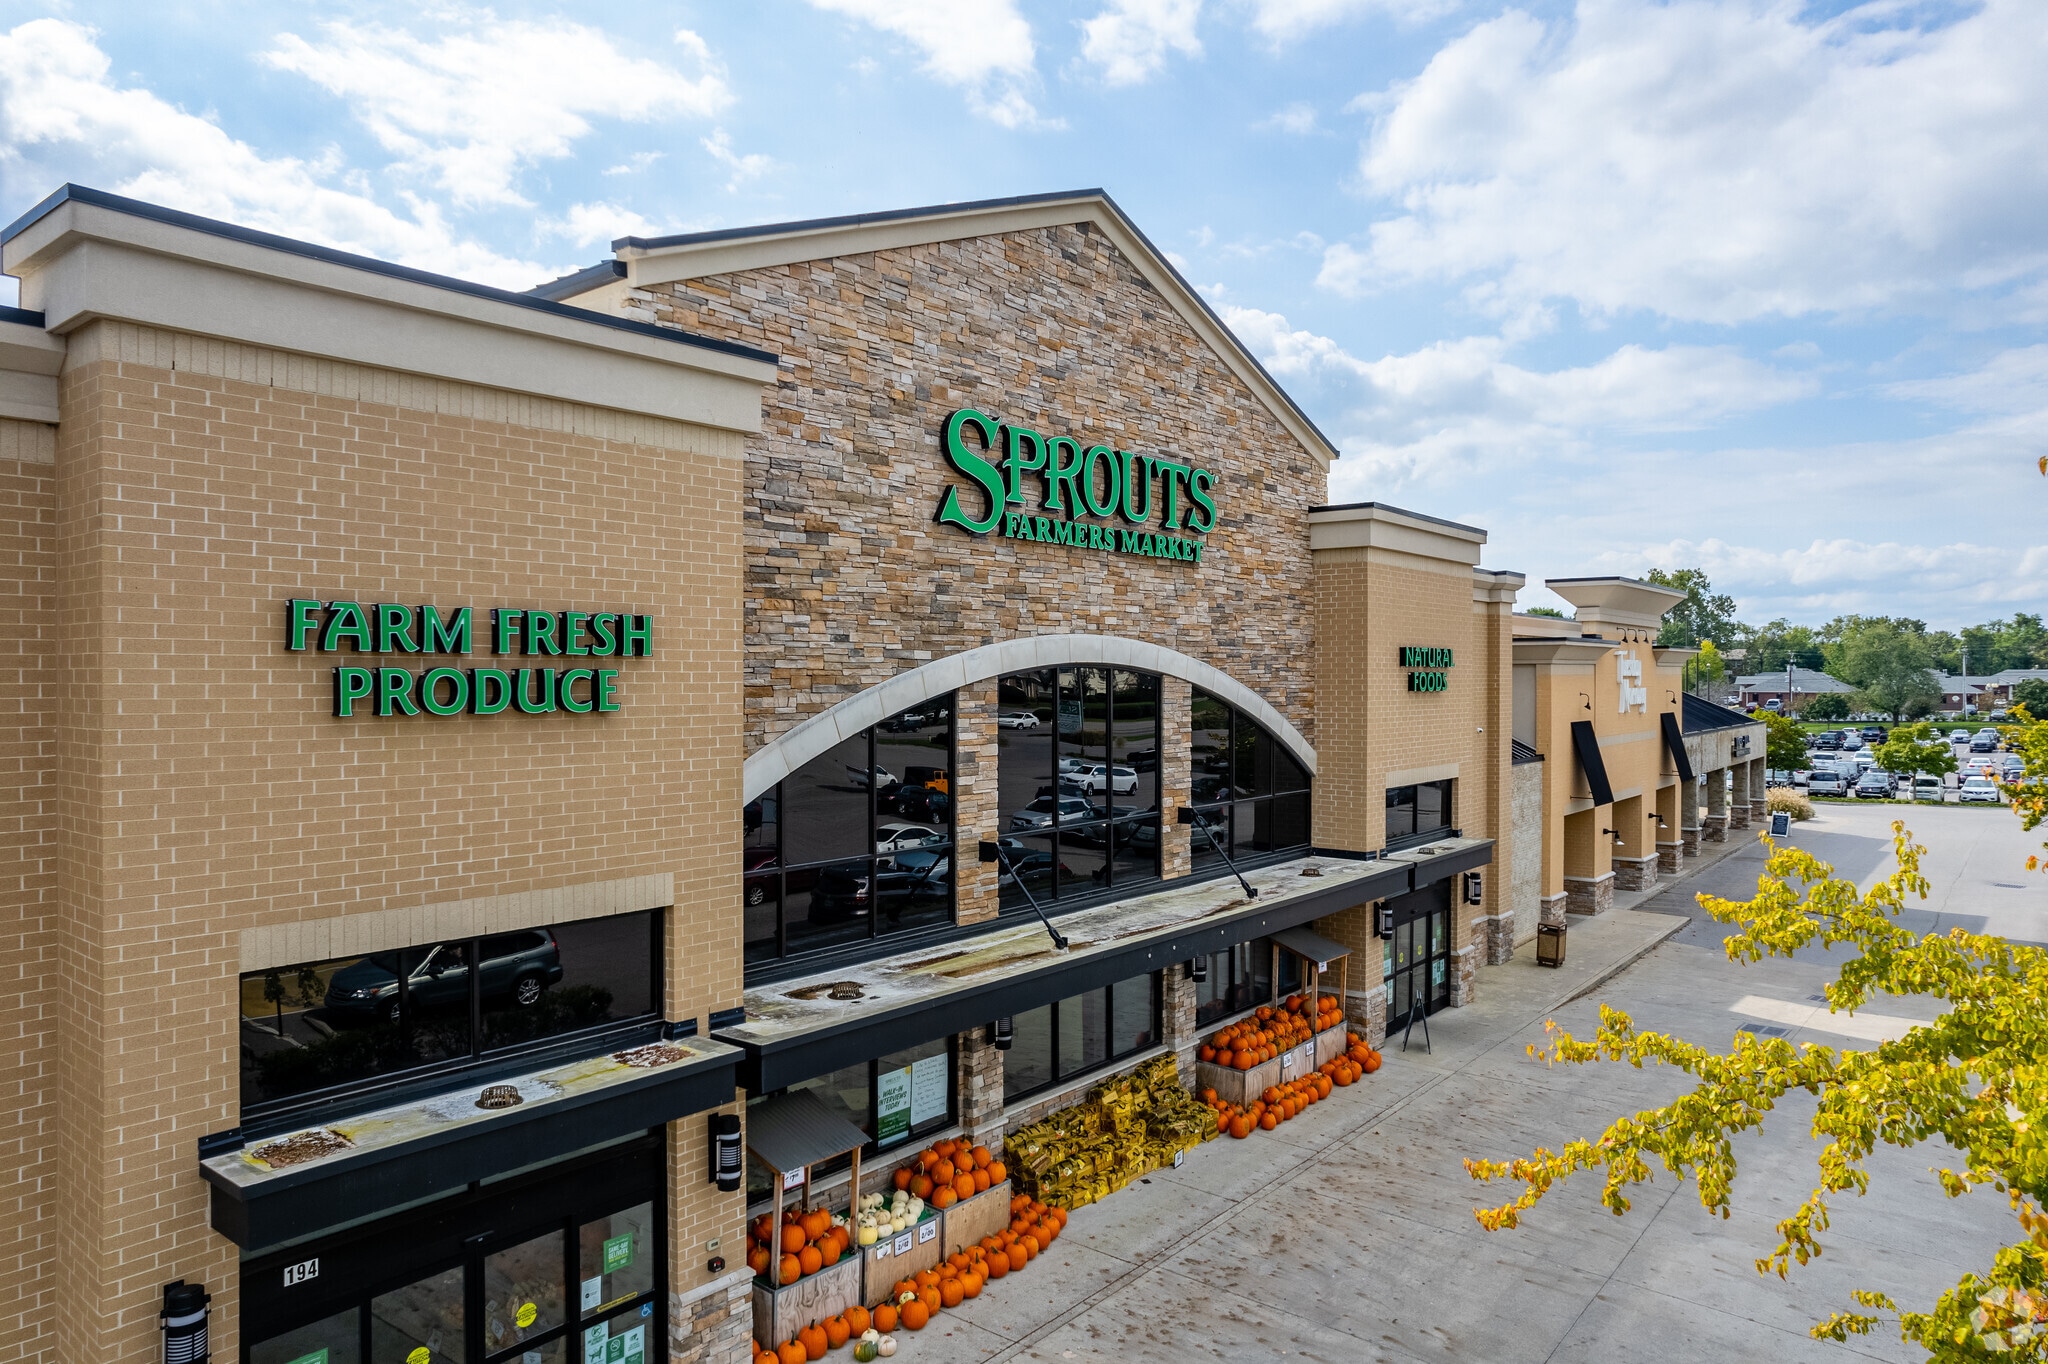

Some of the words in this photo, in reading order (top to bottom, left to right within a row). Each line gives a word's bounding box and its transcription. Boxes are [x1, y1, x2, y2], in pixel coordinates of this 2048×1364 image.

[935, 408, 1217, 534] SPROUTS
[1003, 511, 1116, 551] FARMERS
[1120, 529, 1204, 563] MARKET
[285, 598, 473, 654] FARM
[491, 608, 653, 657] FRESH
[1400, 646, 1455, 668] NATURAL
[332, 666, 621, 717] PRODUCE
[1408, 672, 1448, 692] FOODS
[882, 1084, 904, 1099] WALK-IN
[287, 1260, 317, 1283] 194
